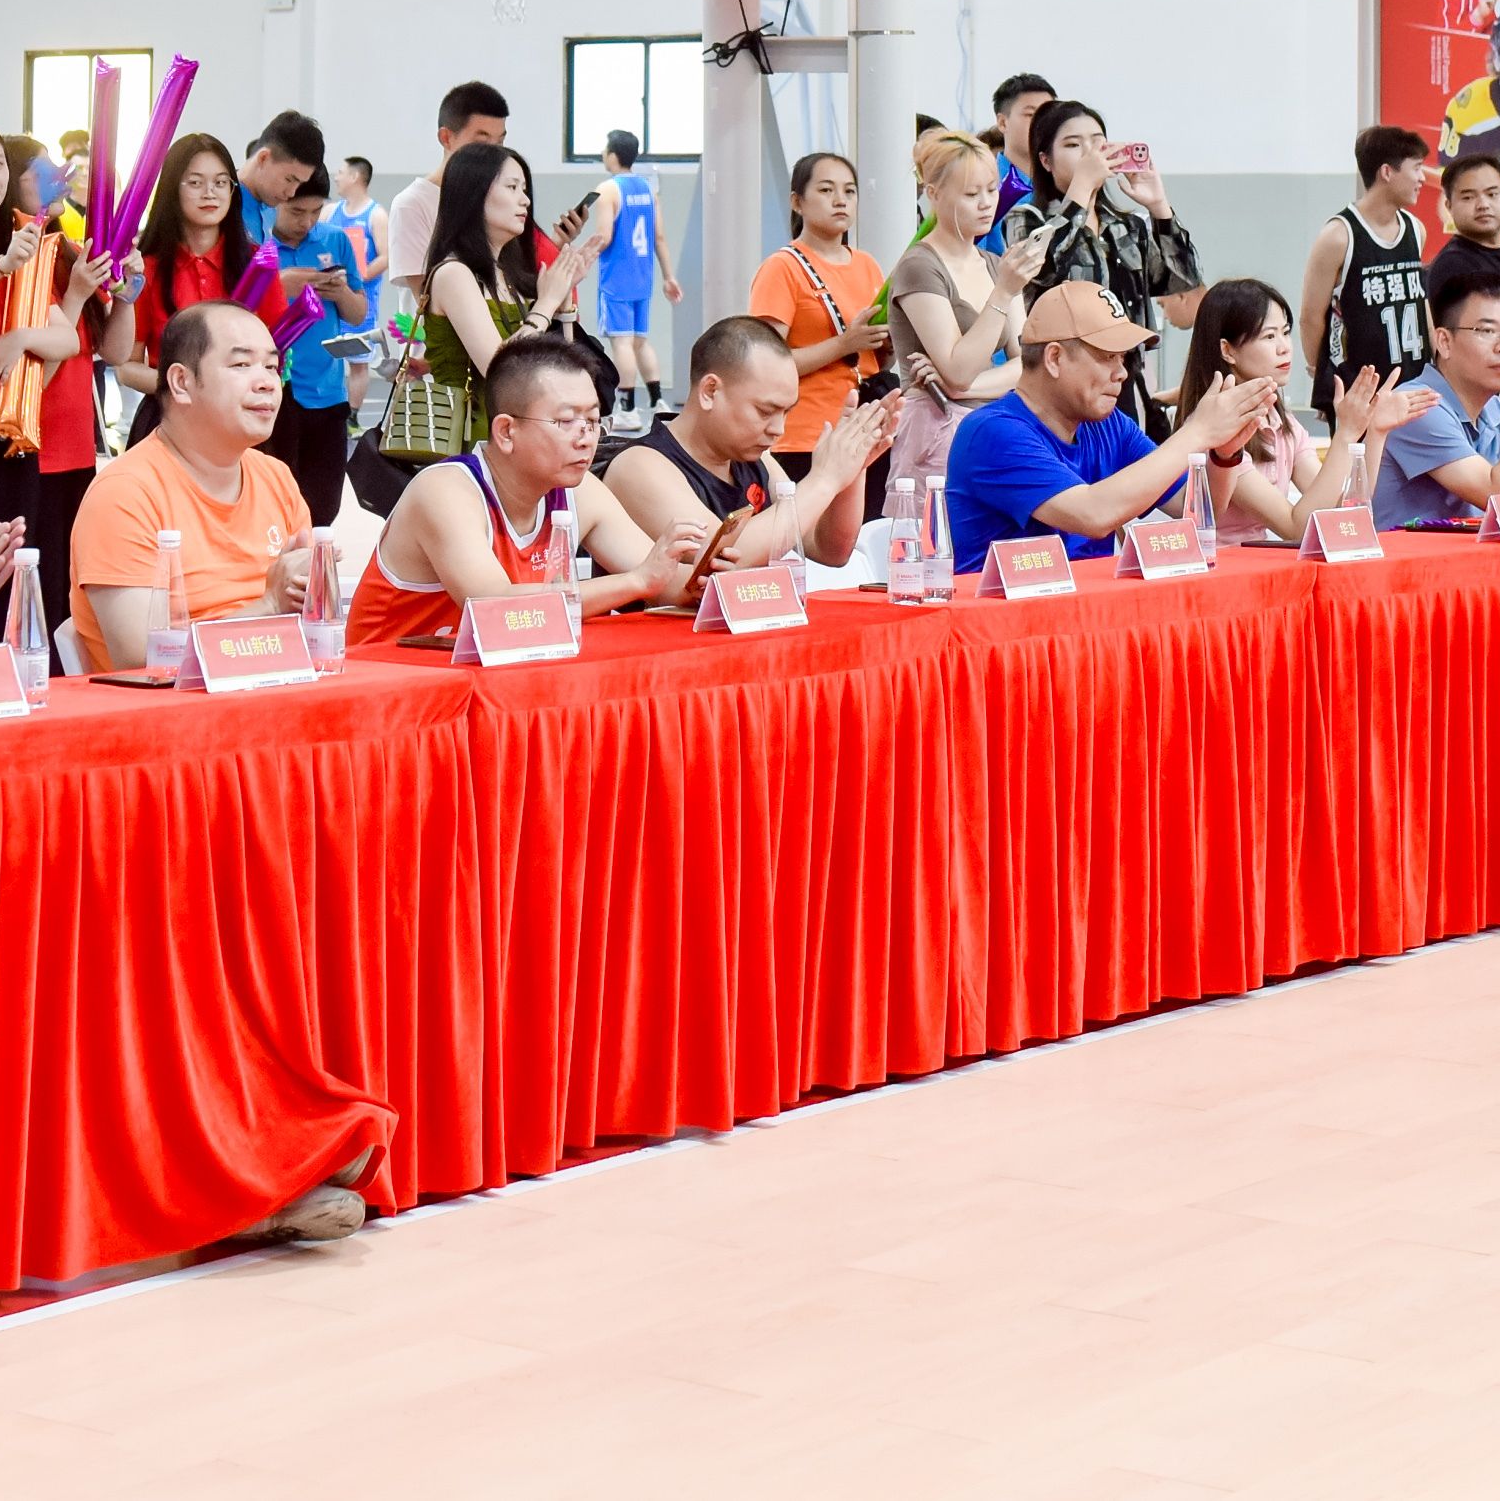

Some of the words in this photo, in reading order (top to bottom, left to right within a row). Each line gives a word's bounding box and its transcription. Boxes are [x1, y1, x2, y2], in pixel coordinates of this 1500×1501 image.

[631, 214, 648, 256] 4
[1362, 270, 1426, 306] 特强队
[1380, 303, 1424, 365] 14
[1011, 549, 1055, 572] 光都智能
[735, 584, 783, 604] 杜邦五金
[504, 608, 547, 632] 德维尔
[218, 633, 283, 659] 粤山新材
